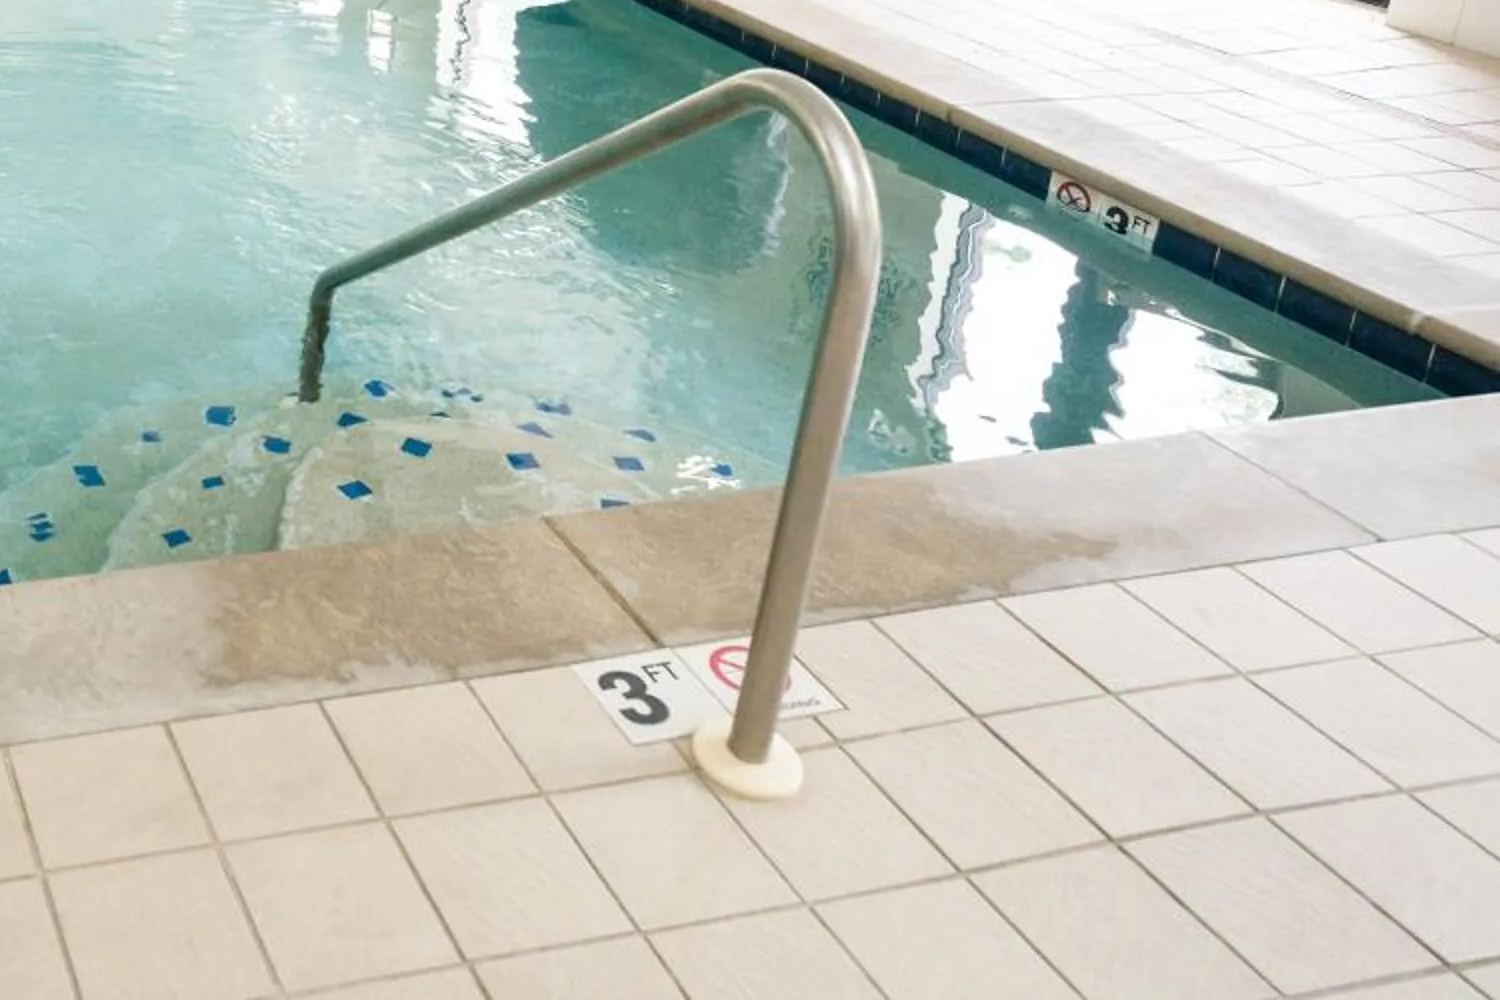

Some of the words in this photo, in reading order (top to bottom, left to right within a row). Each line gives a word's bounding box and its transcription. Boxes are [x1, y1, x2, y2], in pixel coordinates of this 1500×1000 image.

[1103, 206, 1129, 236] 3
[1131, 215, 1151, 235] FT
[597, 670, 670, 726] 3
[641, 660, 680, 684] FT
